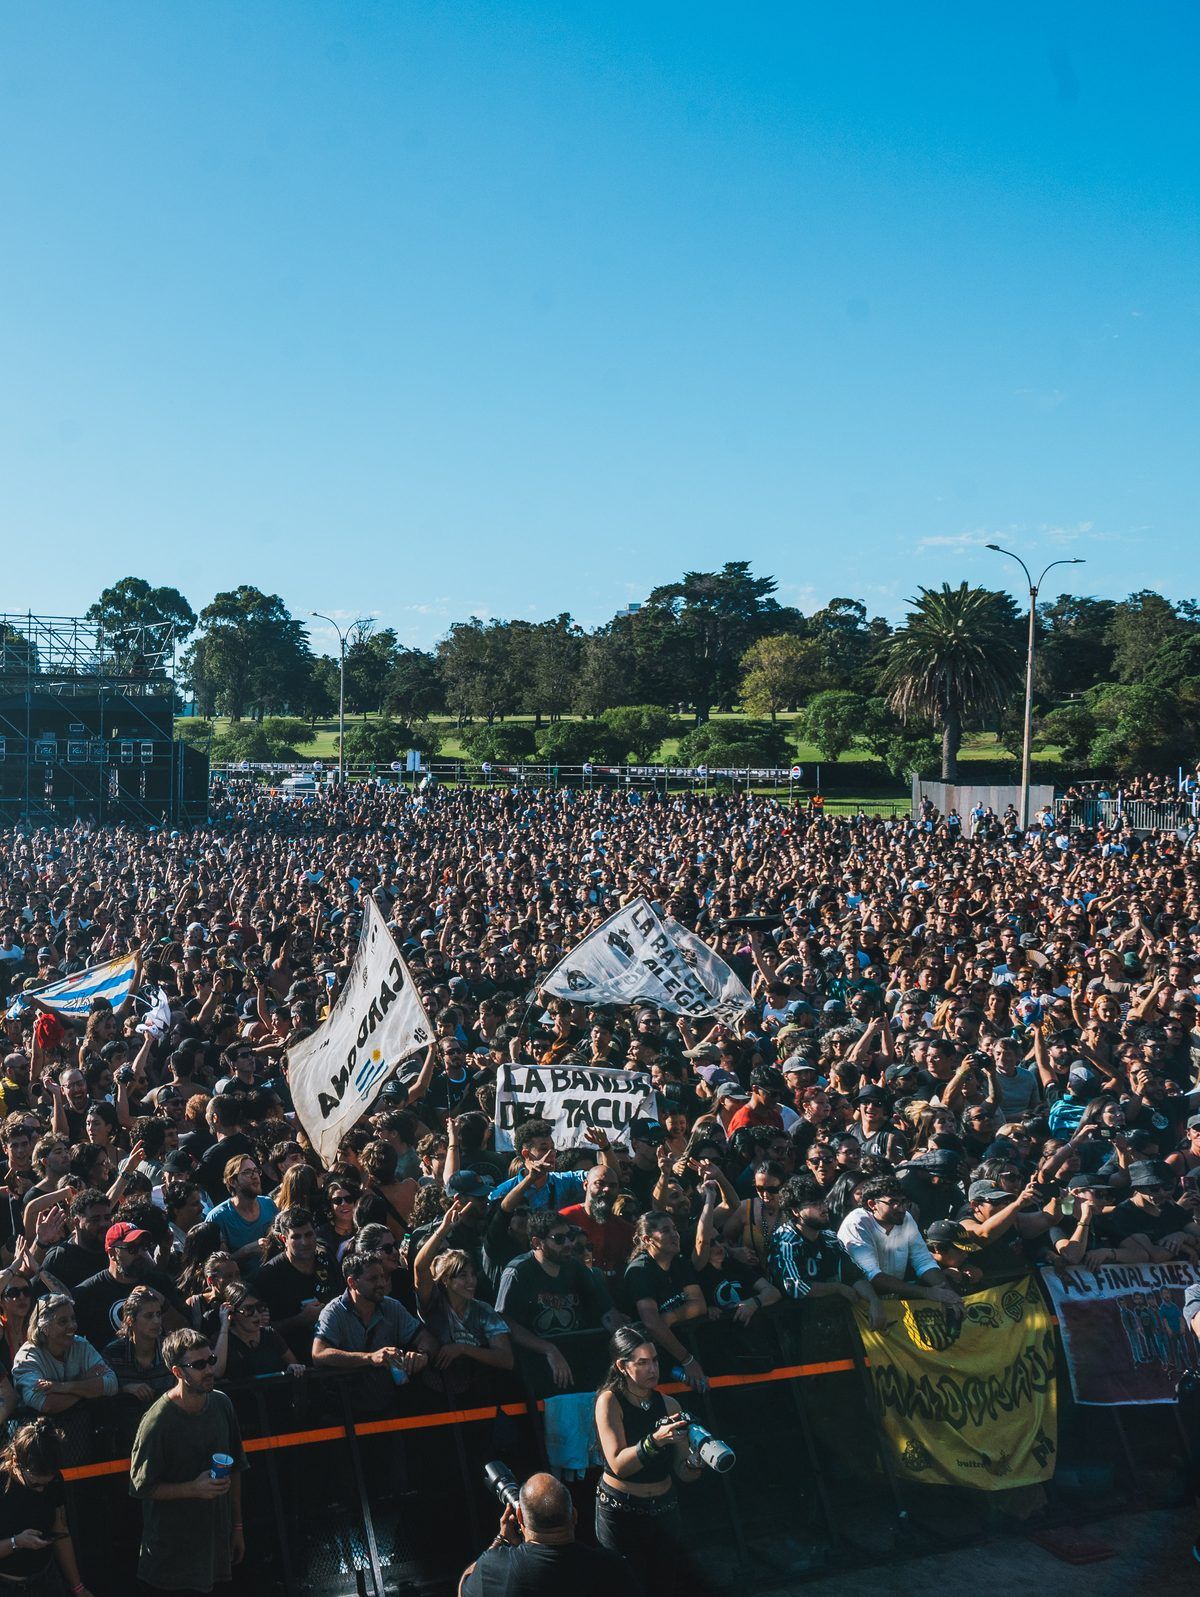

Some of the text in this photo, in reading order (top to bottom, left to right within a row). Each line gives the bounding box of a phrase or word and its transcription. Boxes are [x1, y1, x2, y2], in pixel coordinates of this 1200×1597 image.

[631, 905, 655, 938] LA
[503, 1065, 547, 1093] LA
[500, 1101, 556, 1131] DEL
[1060, 1270, 1092, 1295] AL
